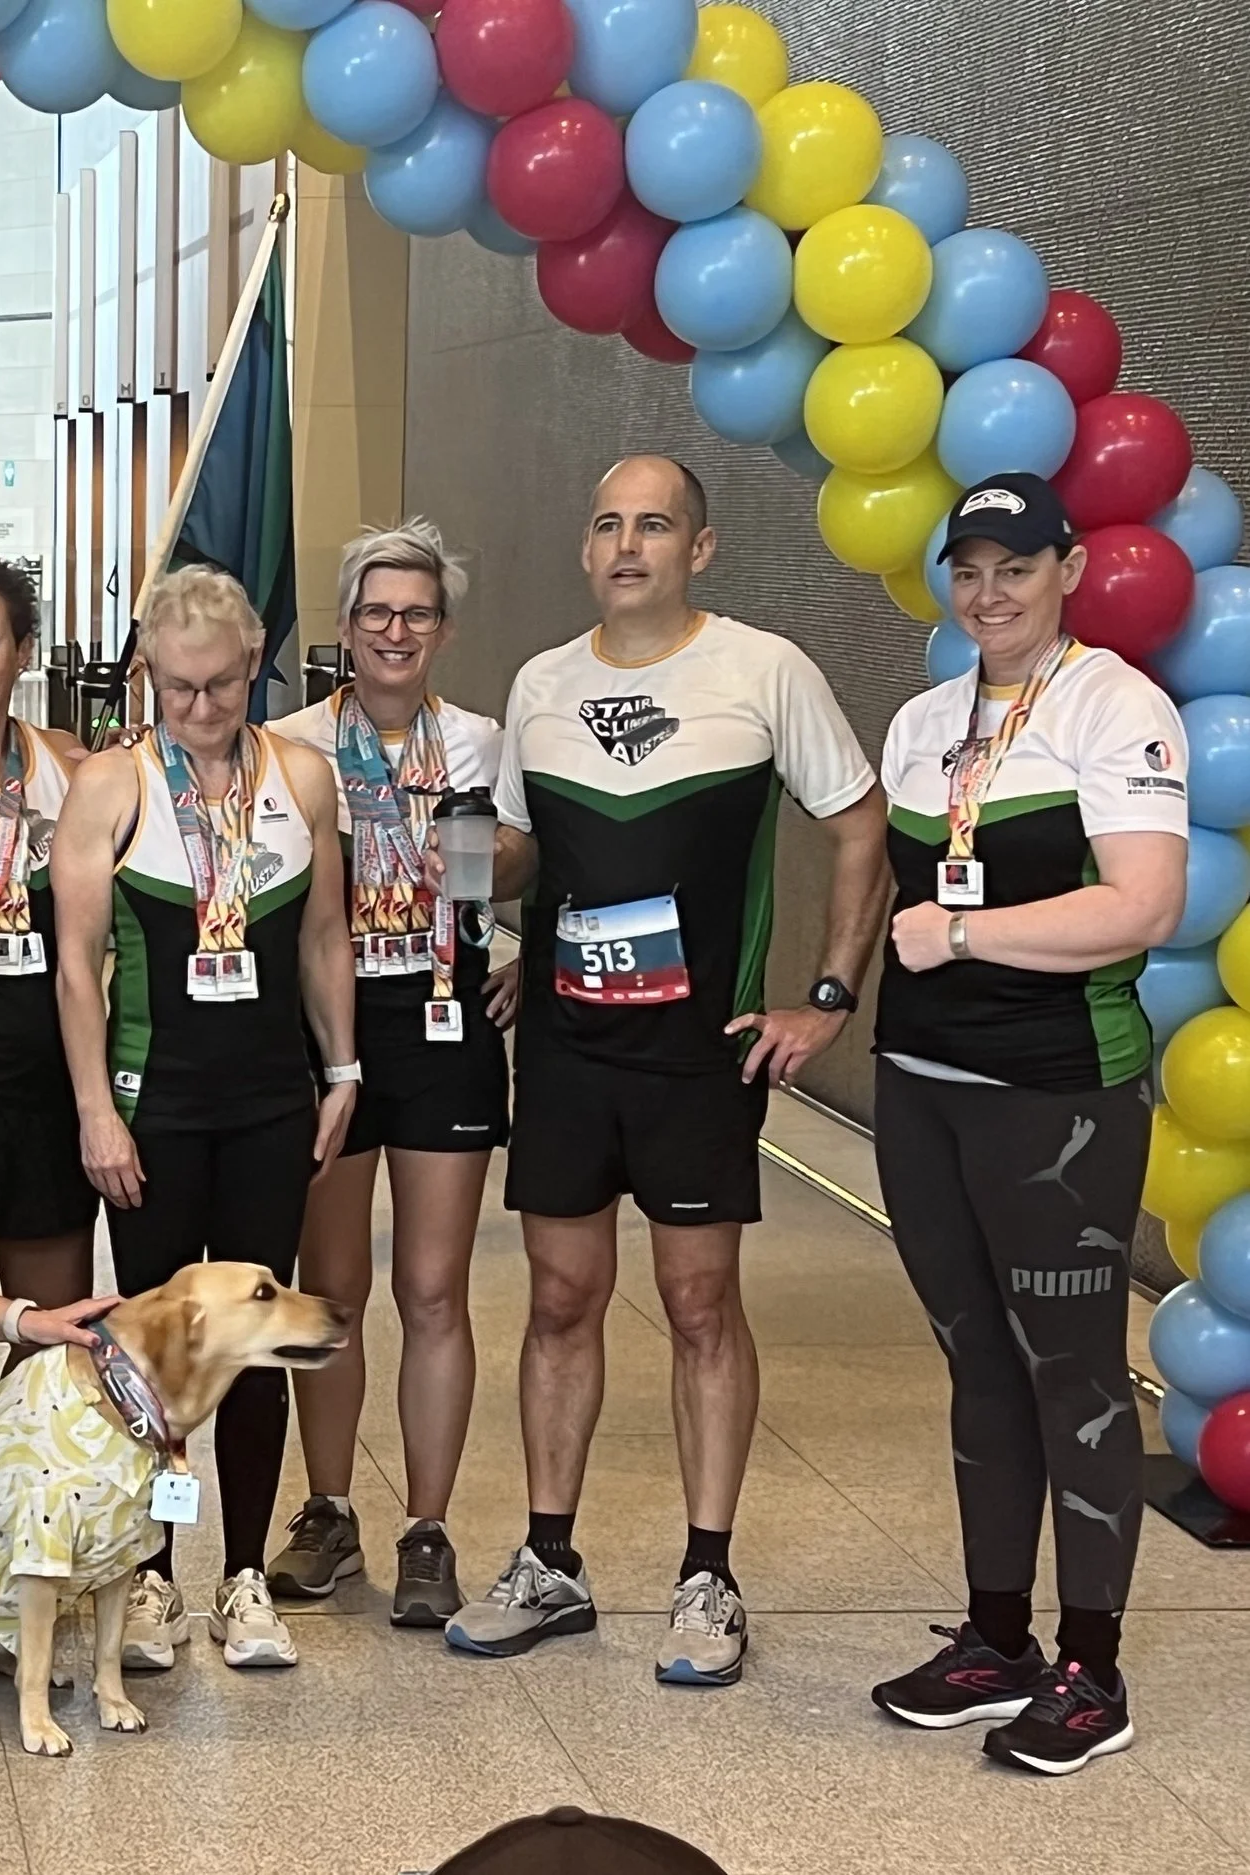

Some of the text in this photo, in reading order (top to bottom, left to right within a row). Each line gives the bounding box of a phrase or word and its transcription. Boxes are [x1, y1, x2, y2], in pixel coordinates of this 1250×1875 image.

[579, 697, 653, 719] STAIR
[580, 940, 637, 973] 513
[1011, 1266, 1113, 1297] PUMA
